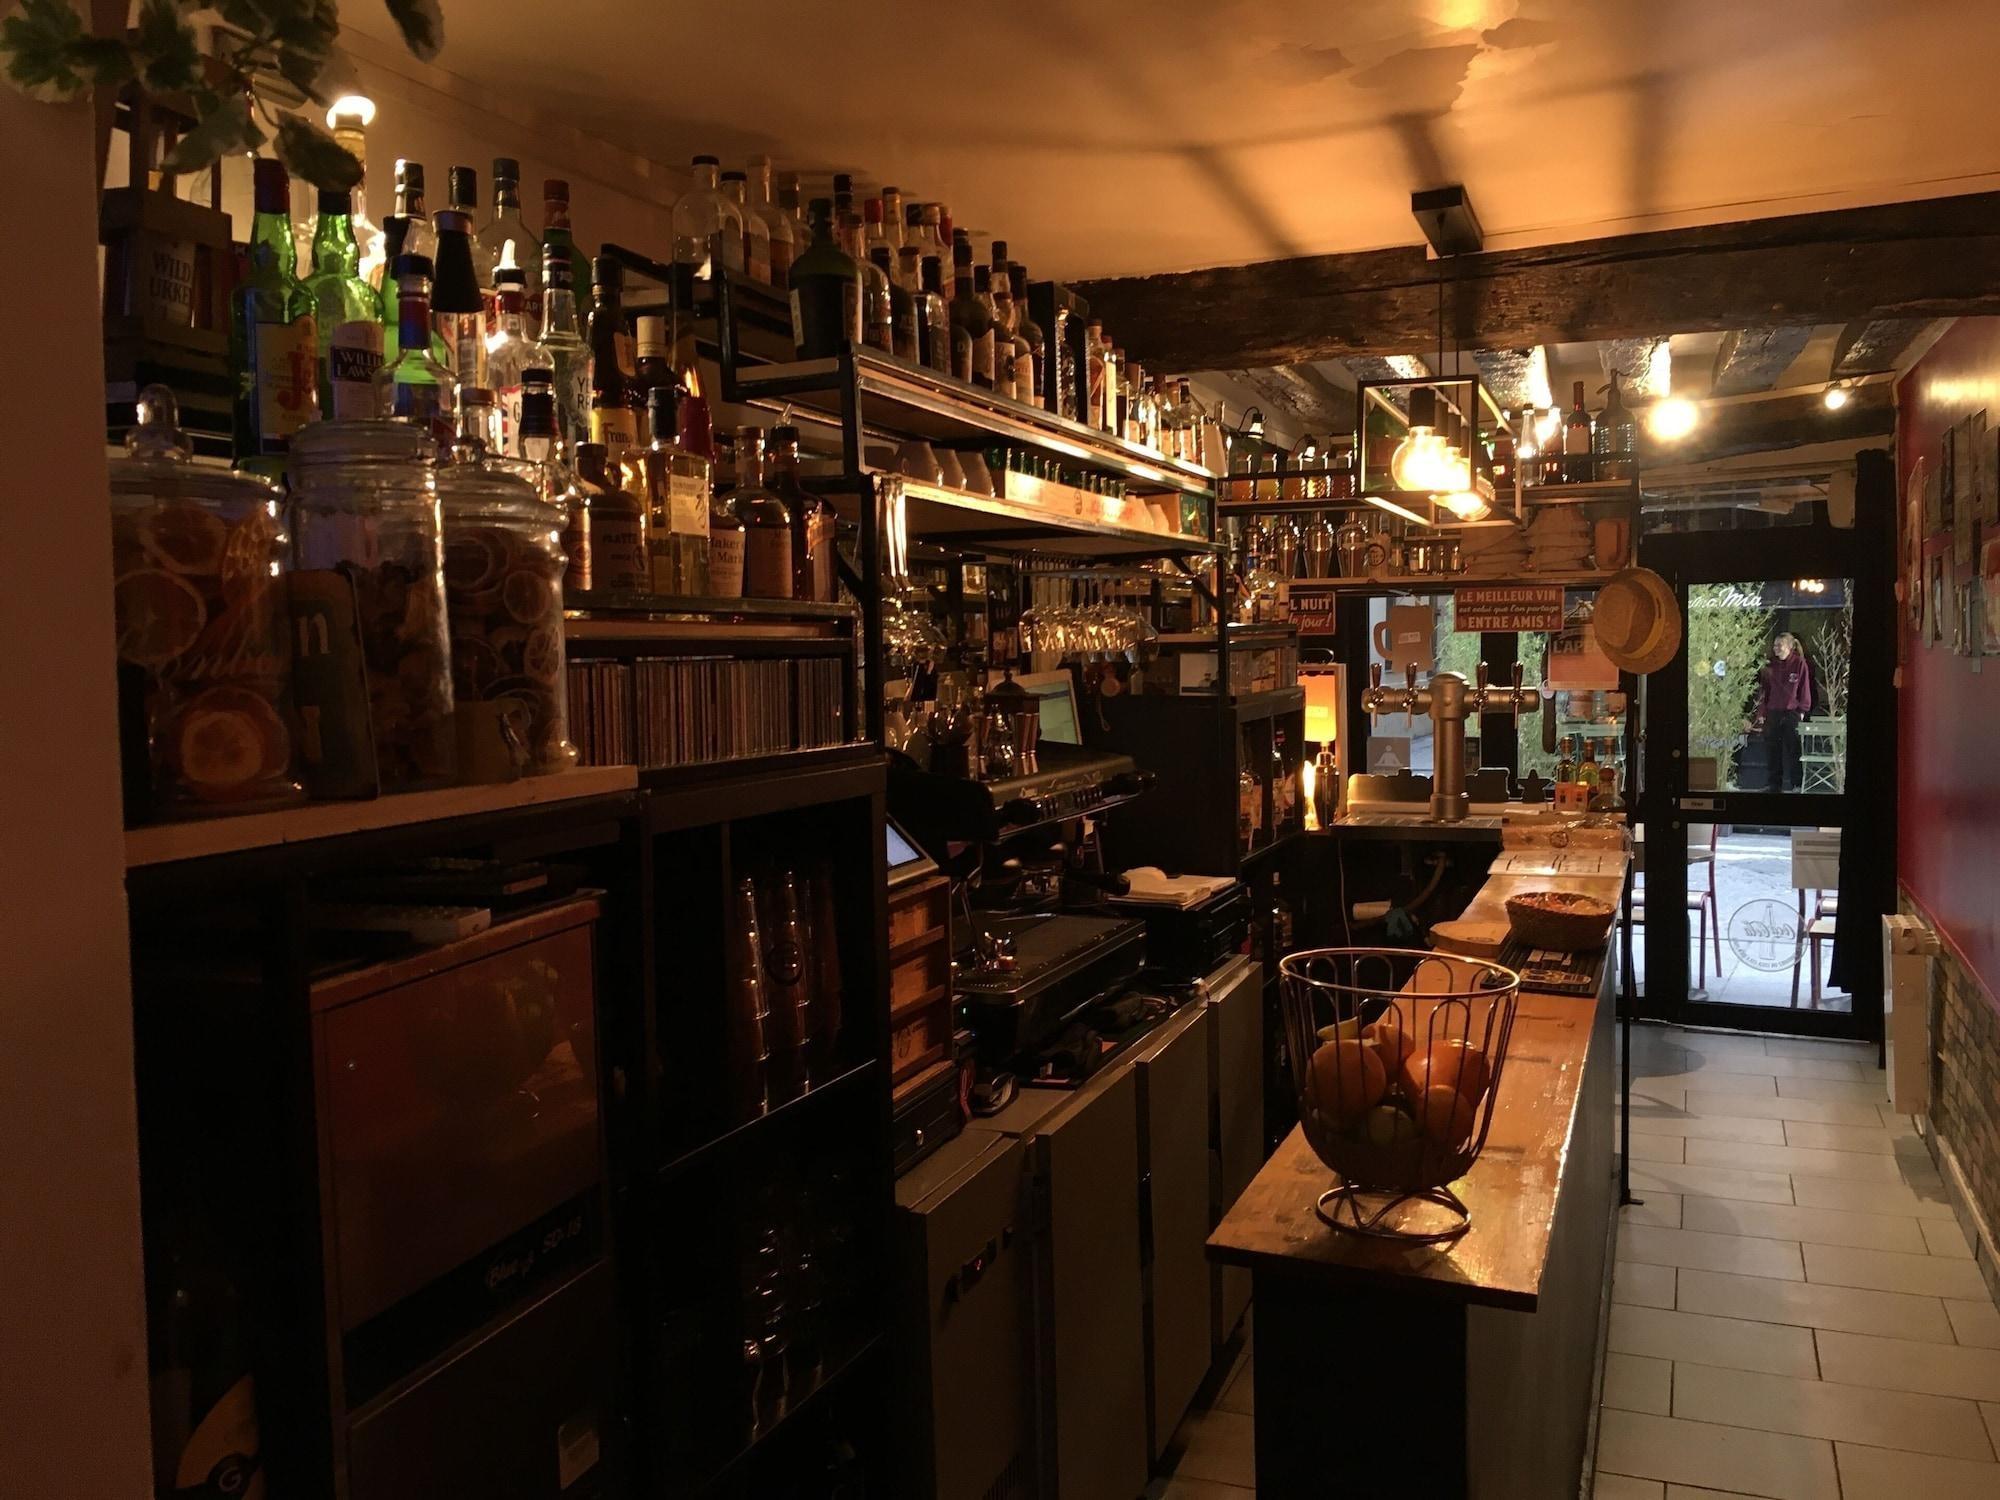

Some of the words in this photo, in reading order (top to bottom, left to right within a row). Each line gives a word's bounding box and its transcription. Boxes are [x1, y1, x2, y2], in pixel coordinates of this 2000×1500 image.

[1460, 592, 1473, 602] LE
[1477, 590, 1534, 602] MEILLEUR
[1536, 589, 1557, 601] VIN
[1301, 598, 1331, 610] NUIT
[1468, 615, 1509, 629] ENTRE
[1512, 615, 1544, 629] AMIS
